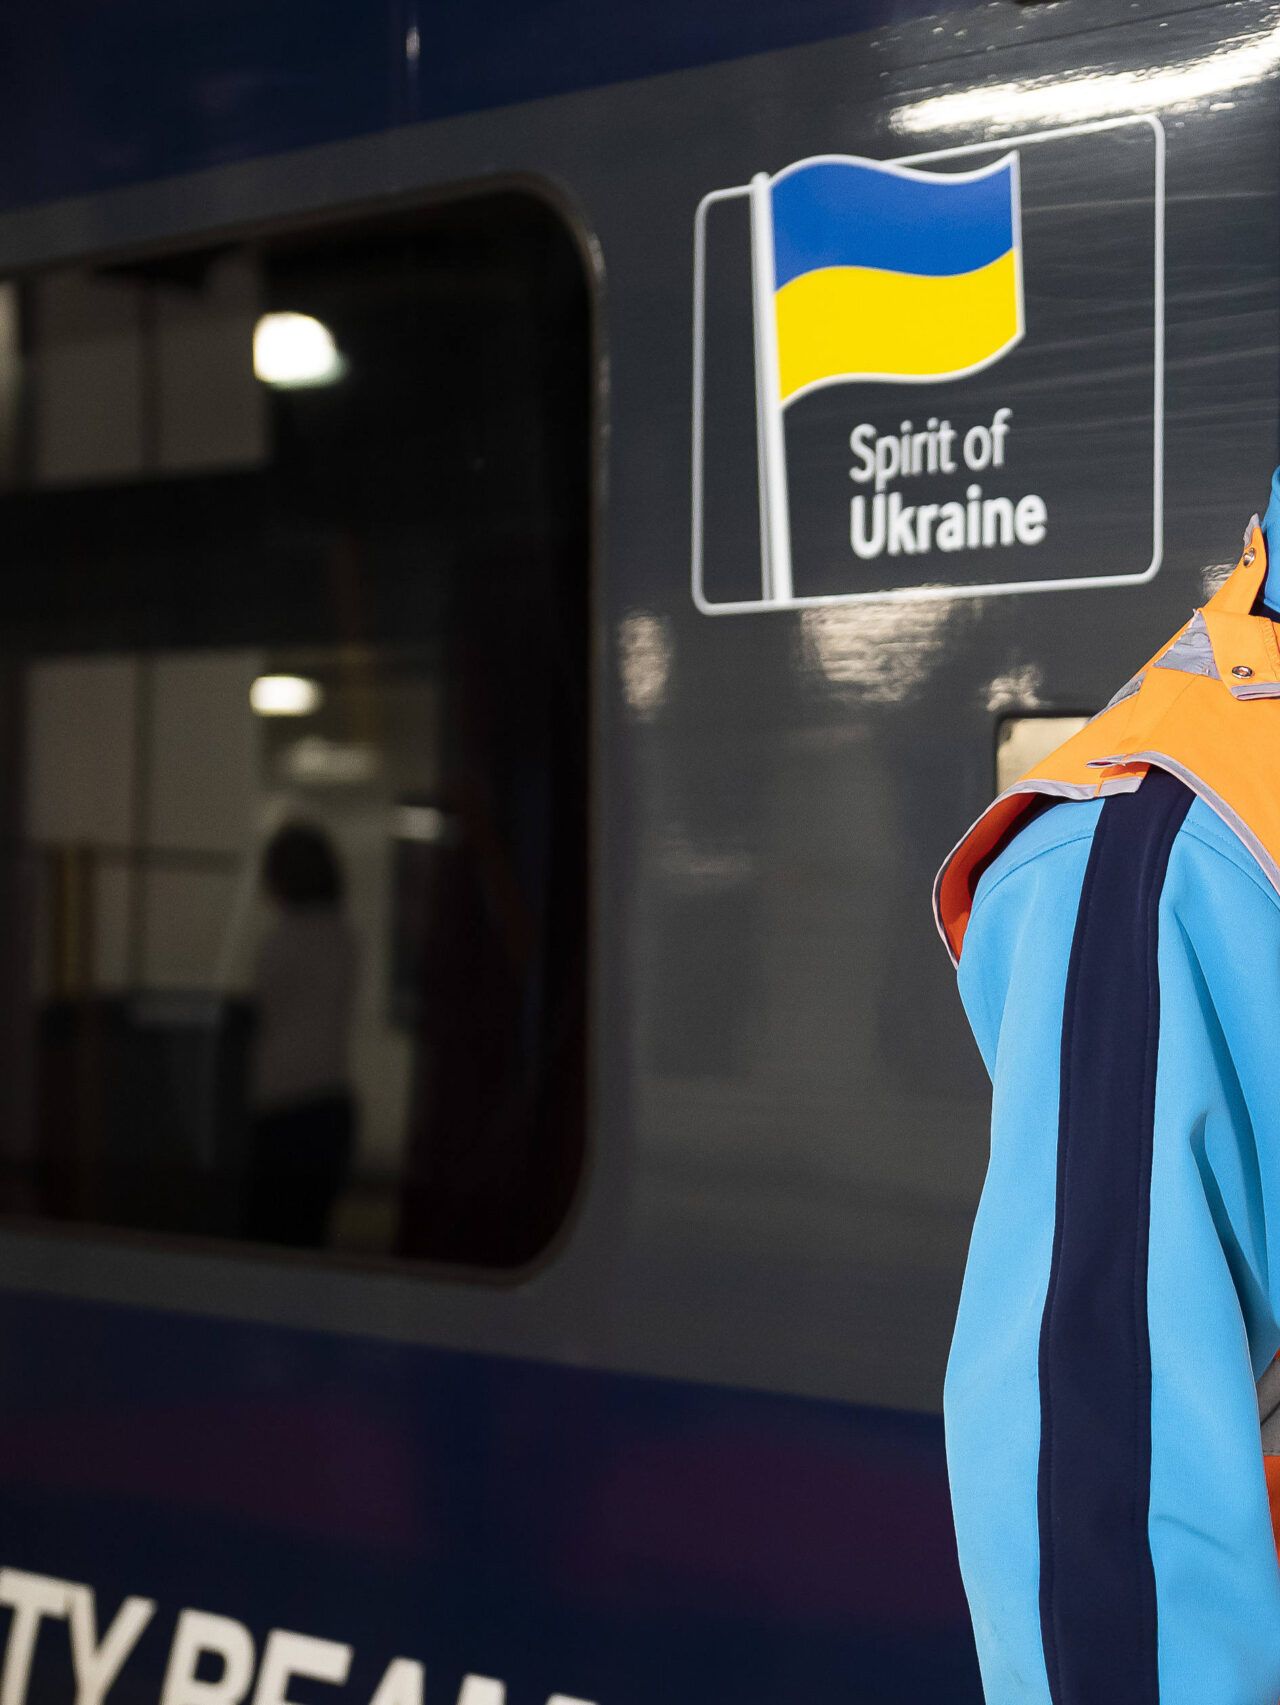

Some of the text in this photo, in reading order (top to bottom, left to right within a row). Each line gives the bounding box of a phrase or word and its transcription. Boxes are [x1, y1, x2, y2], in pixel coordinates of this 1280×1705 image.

[849, 407, 1013, 492] Spirit of
[850, 483, 1048, 559] Ukraine
